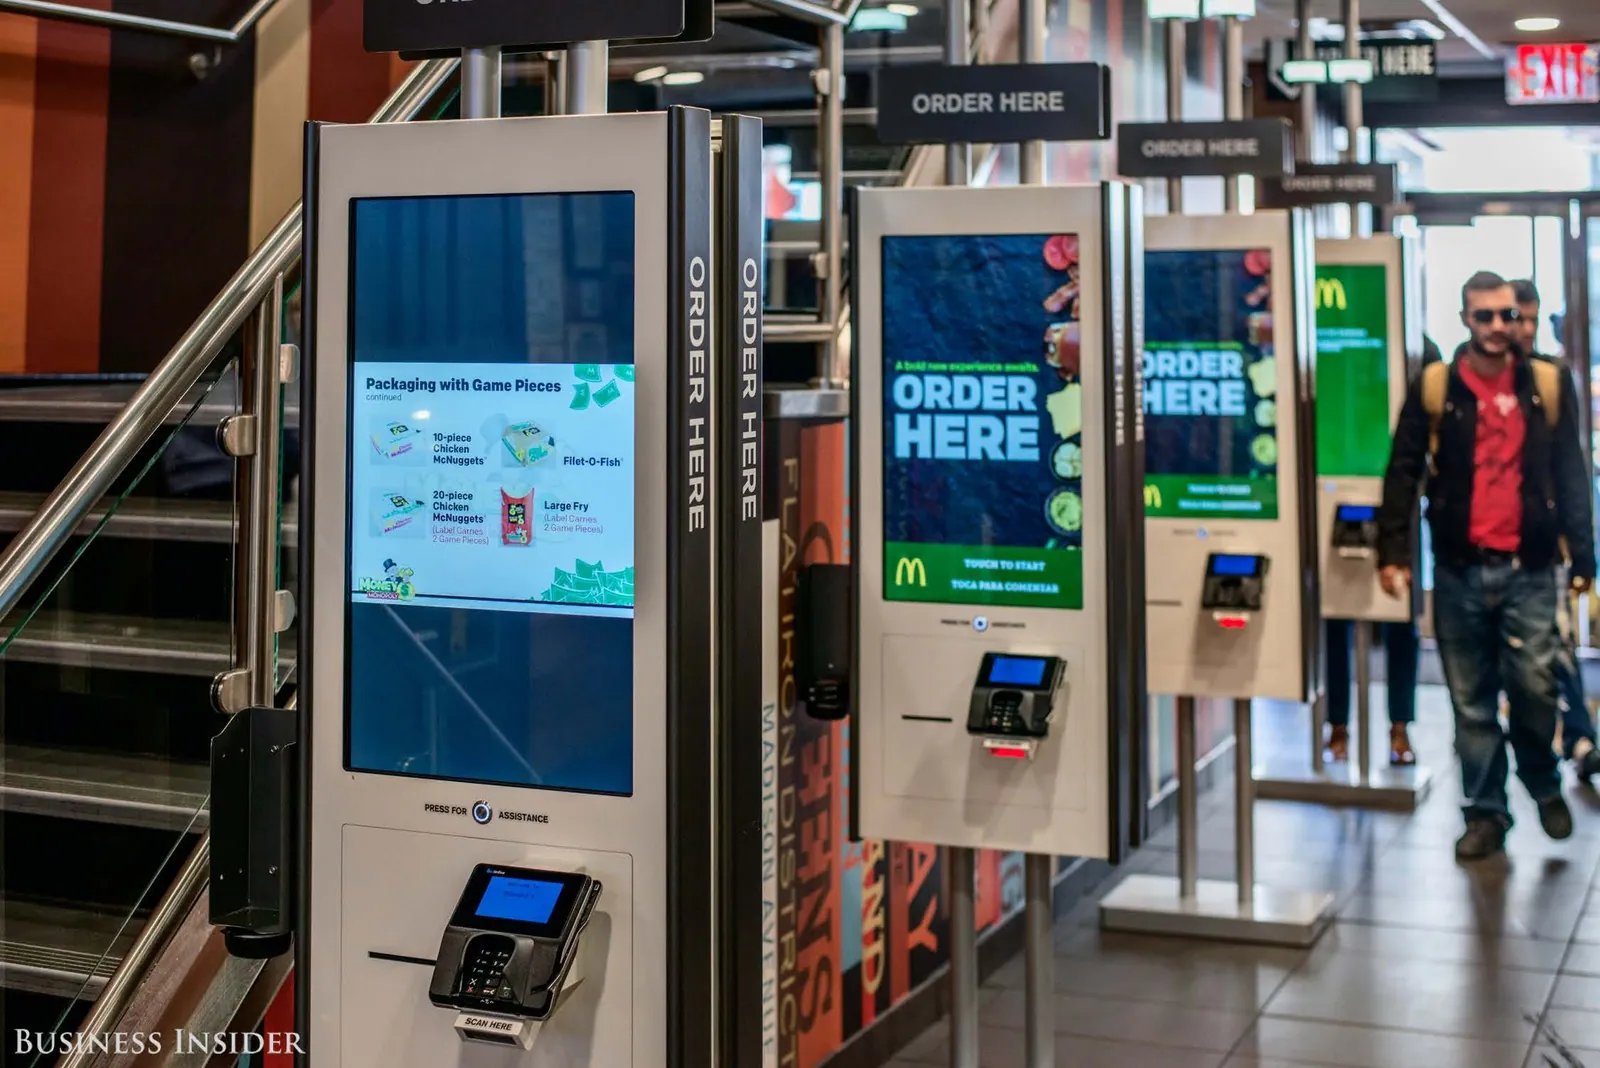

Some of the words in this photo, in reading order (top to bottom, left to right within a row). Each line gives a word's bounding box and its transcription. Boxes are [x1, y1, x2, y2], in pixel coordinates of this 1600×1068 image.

[1516, 44, 1588, 97] EXIT
[912, 93, 994, 115] ORDER
[1000, 91, 1065, 113] HERE
[1141, 140, 1204, 159] ORDER
[1209, 139, 1259, 158] HERE
[689, 256, 705, 404] ORDER
[742, 258, 758, 399] ORDER
[1143, 351, 1243, 378] ORDER
[366, 377, 436, 393] Packaging
[439, 378, 470, 391] with
[472, 378, 512, 392] Game
[515, 379, 562, 393] Pieces
[893, 374, 1038, 411] ORDER
[366, 393, 402, 401] continued
[1142, 380, 1246, 416] HERE
[433, 433, 472, 444] 10-piece
[894, 413, 1040, 461] HERE
[433, 443, 470, 454] Chicken
[433, 455, 485, 467] McNuggets
[563, 456, 621, 467] Filet-O-Fish
[742, 411, 757, 521] HERE
[688, 417, 705, 532] HERE
[433, 491, 473, 502] 20-piece
[432, 502, 469, 512] Chicken
[544, 501, 571, 512] Large
[573, 502, 589, 512] Fry
[432, 513, 485, 525] McNuggets
[544, 513, 568, 522] (Label
[432, 526, 455, 535] (Label
[544, 523, 549, 532] 2
[551, 524, 574, 533] Game
[575, 525, 603, 534] Pieces)
[432, 535, 438, 543] 2
[439, 535, 461, 544] Game
[462, 536, 490, 546] Pieces)
[963, 558, 998, 570] TOUCH
[1000, 560, 1014, 571] TO
[1015, 560, 1046, 572] START
[951, 579, 977, 590] TOCA
[979, 581, 1003, 592] PARA
[762, 703, 776, 881] MADISON
[424, 803, 450, 814] PRESS
[451, 806, 467, 816] FOR
[498, 811, 549, 824] ASSISTANCE
[762, 899, 776, 1057] AVENUE
[464, 1017, 488, 1028] SCAN
[489, 1020, 513, 1032] HERE
